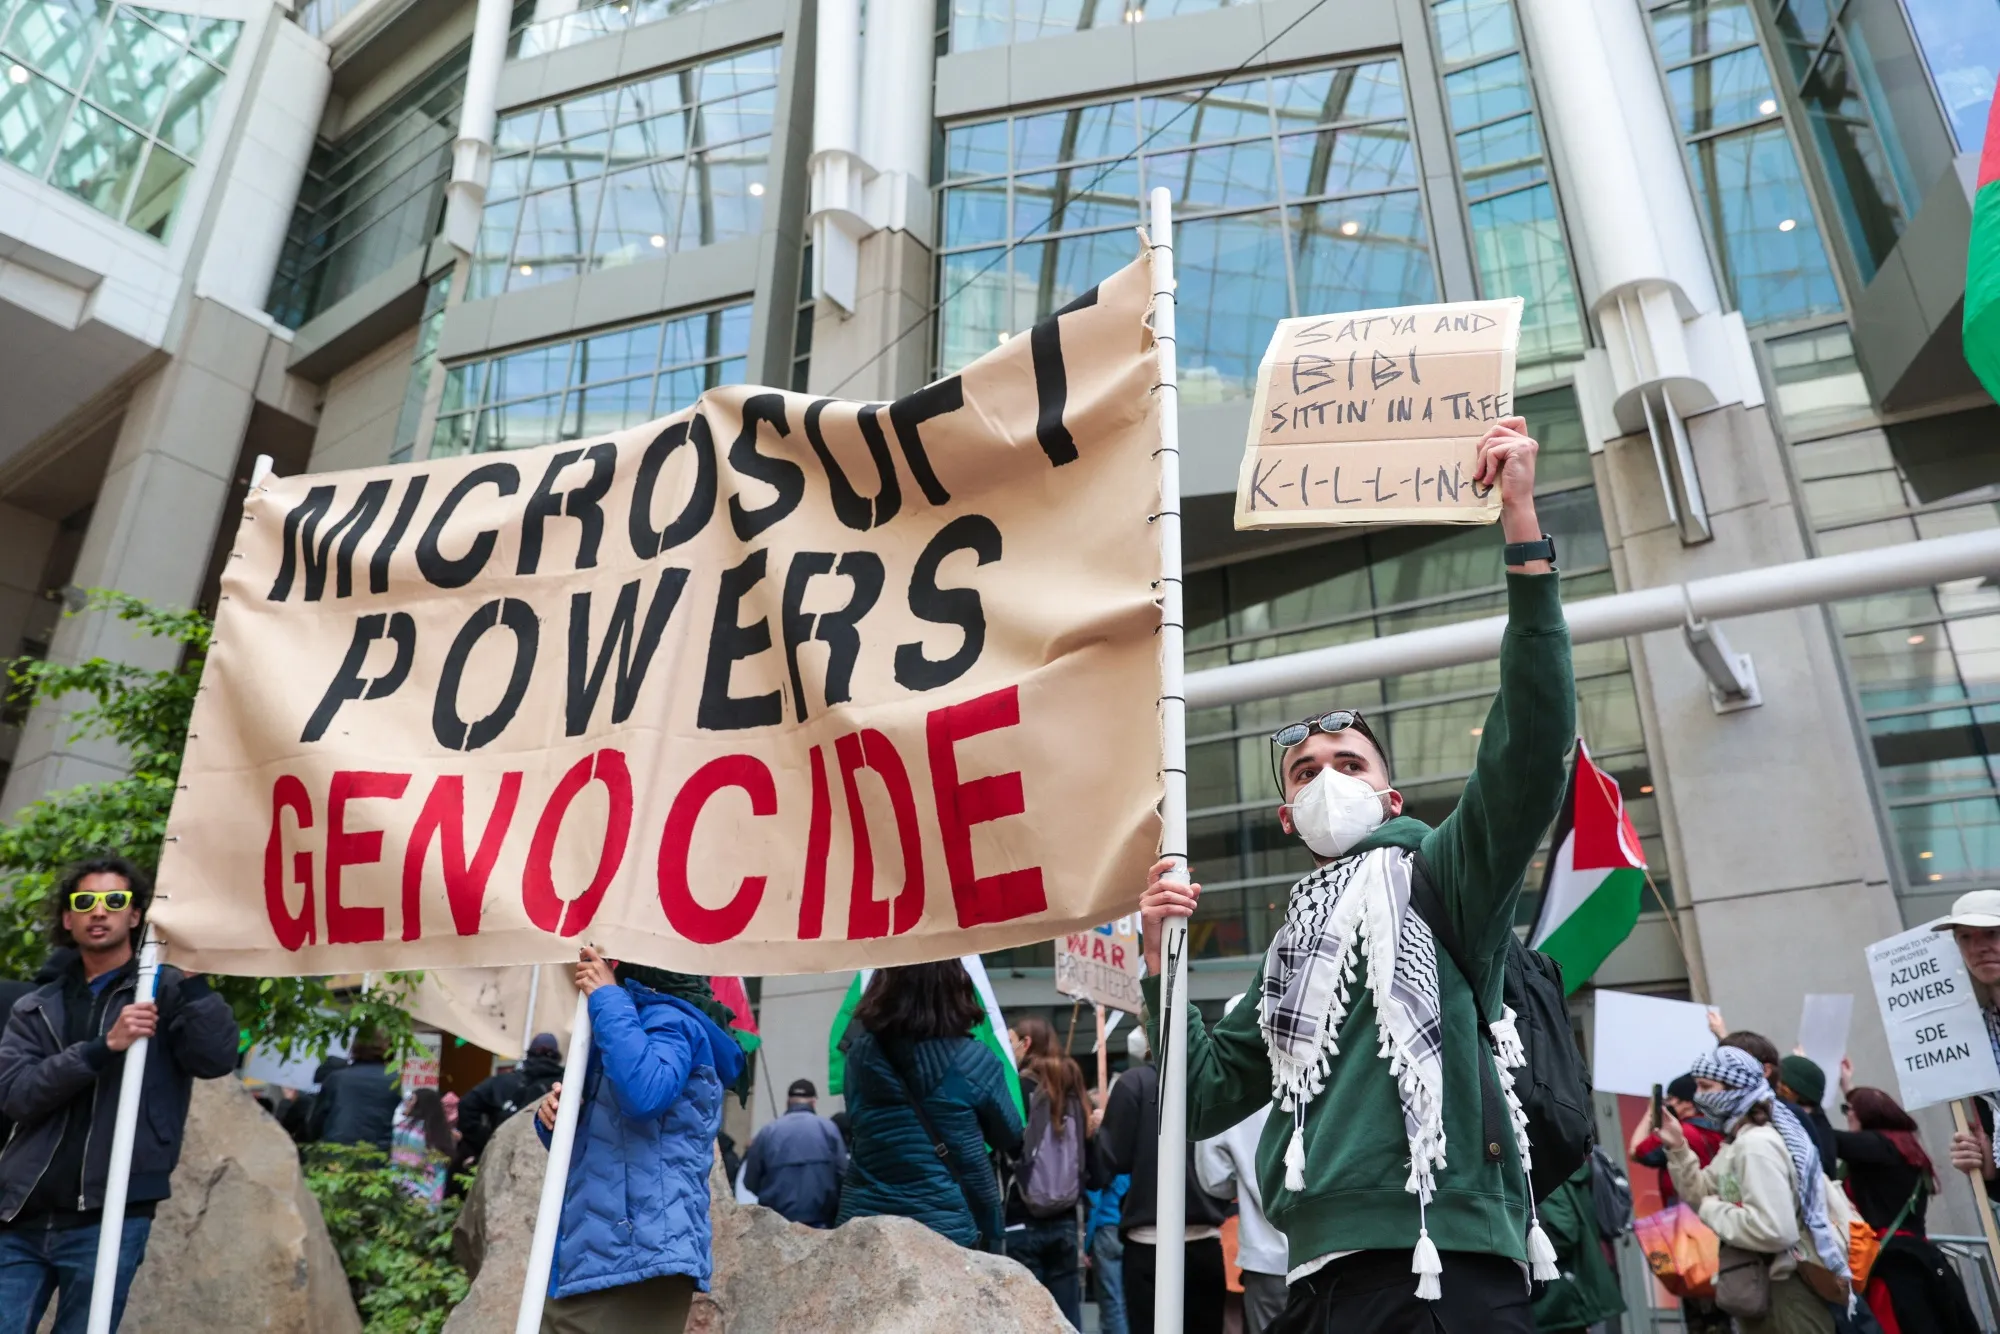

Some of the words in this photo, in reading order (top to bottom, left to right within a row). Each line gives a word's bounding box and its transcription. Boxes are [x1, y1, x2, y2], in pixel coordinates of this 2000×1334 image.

[1293, 314, 1417, 347] SATYA
[1433, 312, 1498, 334] AND
[1292, 345, 1421, 396] BIBI
[1268, 398, 1375, 434] SITTIN'
[1387, 395, 1412, 424] IN
[1421, 403, 1434, 423] A
[1440, 391, 1512, 423] TREE
[300, 514, 1003, 752] POWERS
[264, 685, 1049, 952] GENOCIDE
[1066, 933, 1126, 970] WAR
[1889, 947, 1929, 966] EMPLOYEES
[1910, 939, 1922, 949] TO
[1890, 957, 1940, 988] AZURE
[1887, 978, 1955, 1012] POWERS
[1915, 1023, 1949, 1045] SDE
[1904, 1042, 1971, 1072] TEIMAN
